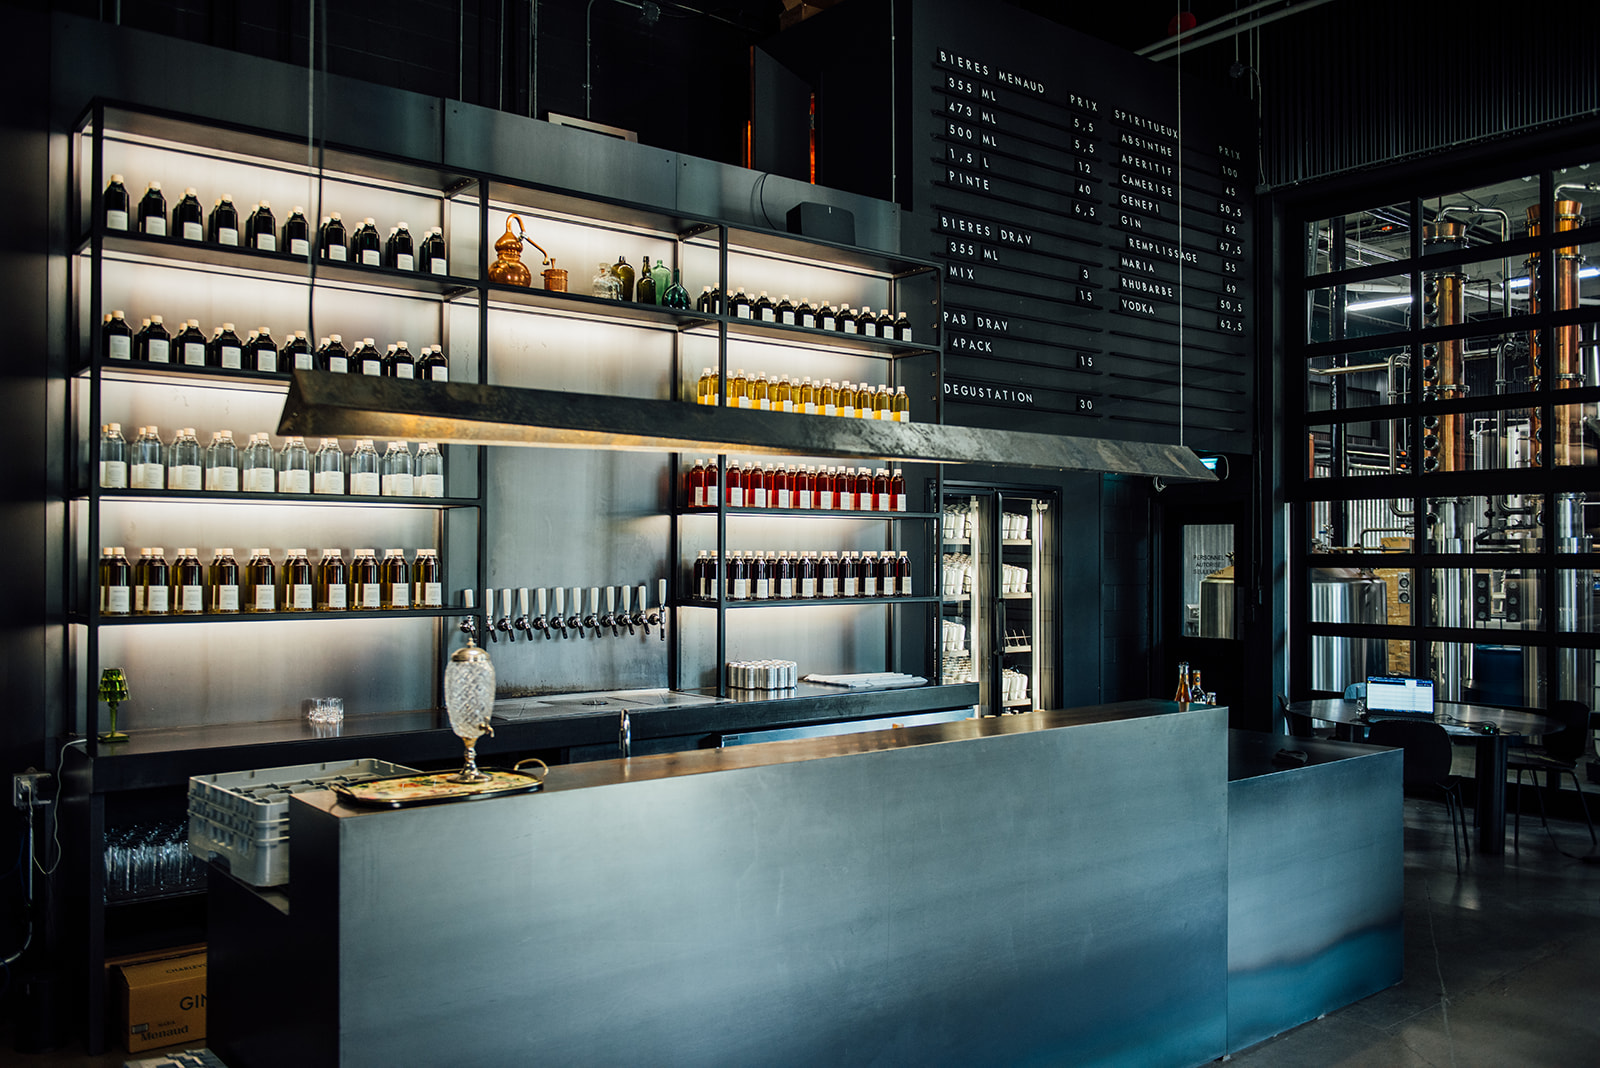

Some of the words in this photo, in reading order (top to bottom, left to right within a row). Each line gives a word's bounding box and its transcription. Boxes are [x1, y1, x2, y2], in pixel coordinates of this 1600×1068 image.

[940, 50, 989, 76] BIERES
[998, 71, 1045, 94] MENAUD
[948, 77, 972, 94] 355
[981, 88, 996, 102] ML
[1070, 94, 1098, 112] PRIX
[949, 102, 972, 117] 473
[982, 111, 997, 125] ML
[1114, 109, 1178, 139] SPIRITUEUX
[949, 123, 973, 140] 500
[982, 134, 997, 147] ML
[1121, 133, 1173, 157] ABSINTHE
[1218, 145, 1241, 161] PRIX
[983, 157, 989, 169] L
[1078, 161, 1091, 174] 12
[1121, 153, 1173, 177] APERITIF
[1222, 165, 1238, 179] 100
[949, 170, 990, 191] PINTE
[1121, 174, 1173, 197] CAMERISE
[1078, 183, 1091, 195] 40
[1225, 186, 1237, 197] 45
[1120, 194, 1160, 213] GENEPI
[1120, 215, 1142, 229] GIN
[1225, 224, 1237, 235] 62
[941, 216, 991, 237] BIERES
[1000, 229, 1032, 245] DRAV
[950, 241, 974, 256] 355
[983, 248, 998, 261] ML
[1128, 237, 1198, 264] REMPLISSAGE
[949, 265, 974, 280] MIX
[1121, 257, 1155, 273] MARIA
[1225, 262, 1236, 273] 55
[1083, 269, 1089, 279] 3
[1121, 277, 1173, 298] RHUBARBE
[1226, 283, 1237, 294] 69
[1080, 290, 1093, 302] 15
[1121, 299, 1155, 315] VODKA
[943, 311, 967, 325] PAB
[977, 316, 1008, 331] DRAV
[952, 337, 992, 353] 4PACK
[1080, 355, 1093, 367] 15
[943, 382, 1033, 403] DEGUSTATION
[1079, 399, 1093, 410] 30
